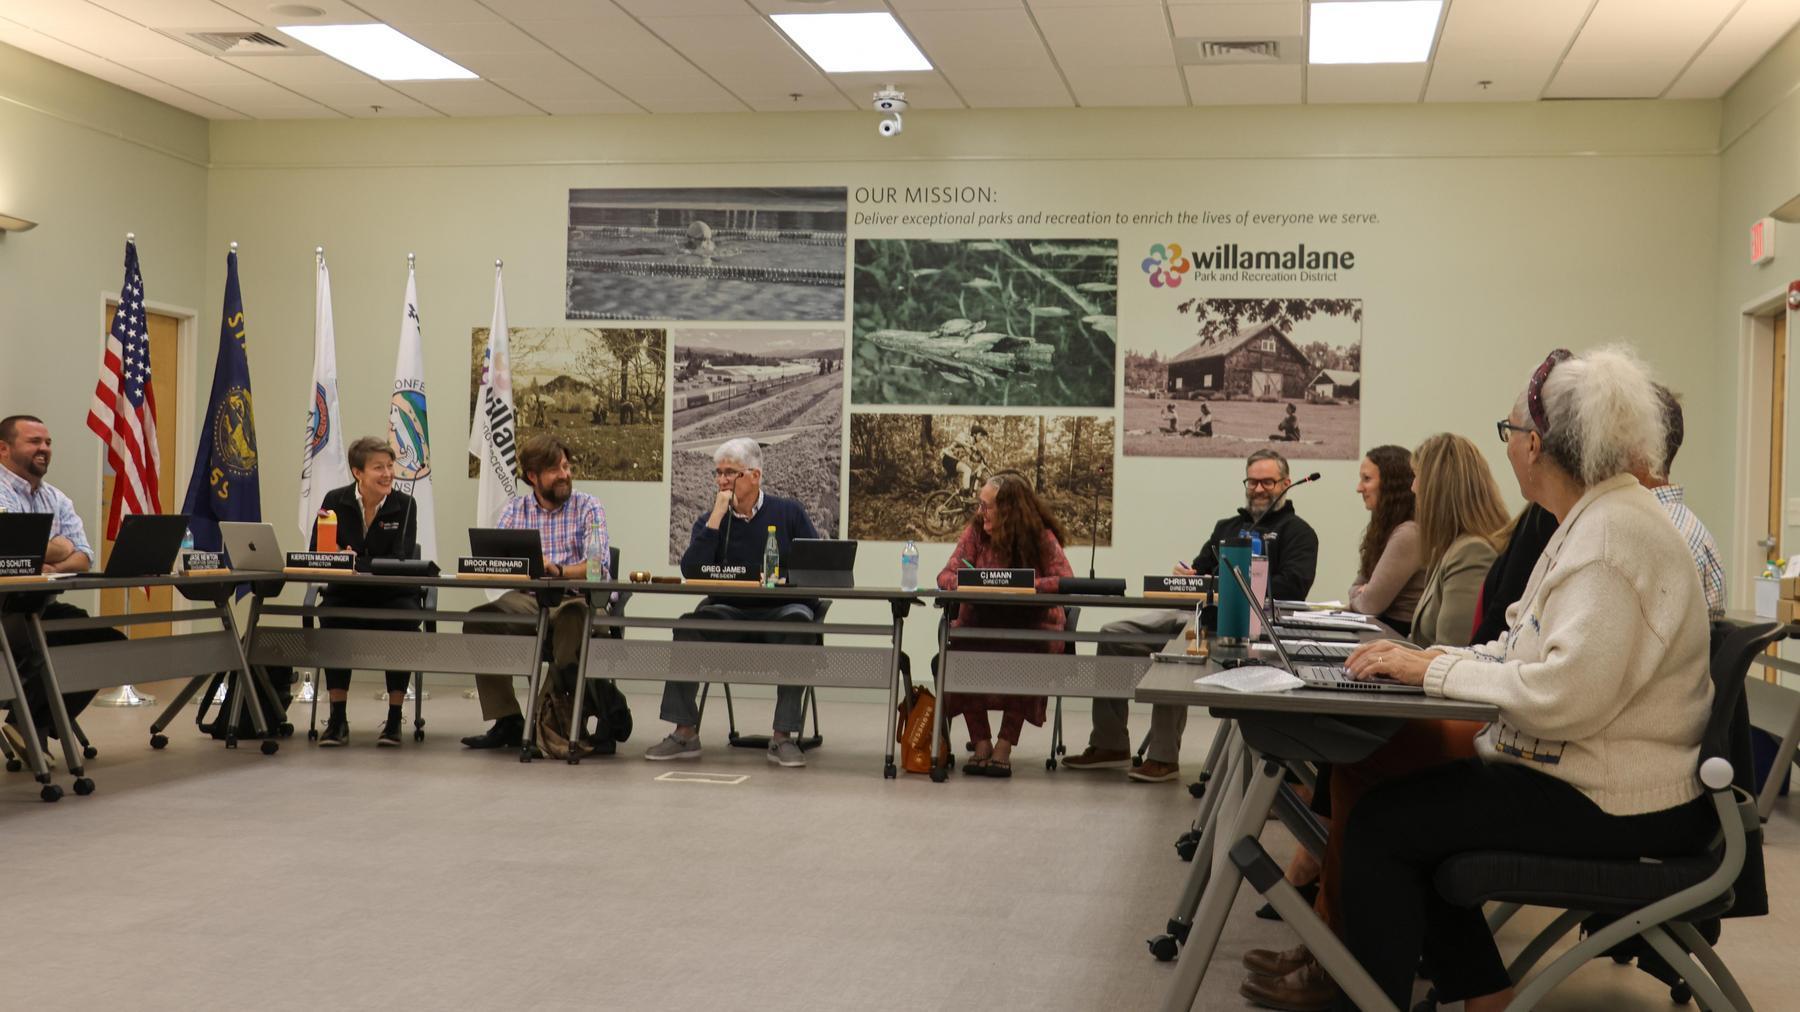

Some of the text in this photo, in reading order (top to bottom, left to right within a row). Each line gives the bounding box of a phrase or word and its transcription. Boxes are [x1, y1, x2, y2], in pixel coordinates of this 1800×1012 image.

[855, 187, 998, 204] OUR MISSION:
[854, 210, 1381, 228] Deliver exceptional parks and recreation to enrich the lives of everyone we serve.
[1191, 243, 1355, 270] willamalane
[1194, 271, 1338, 282] Park and Recreation District
[6, 559, 32, 568] SCHUTTE
[464, 559, 523, 569] BROOK REINHARD
[701, 565, 747, 574] GREG JAMES
[989, 571, 1012, 579] MANN
[1163, 577, 1204, 587] CHRIS WIG
